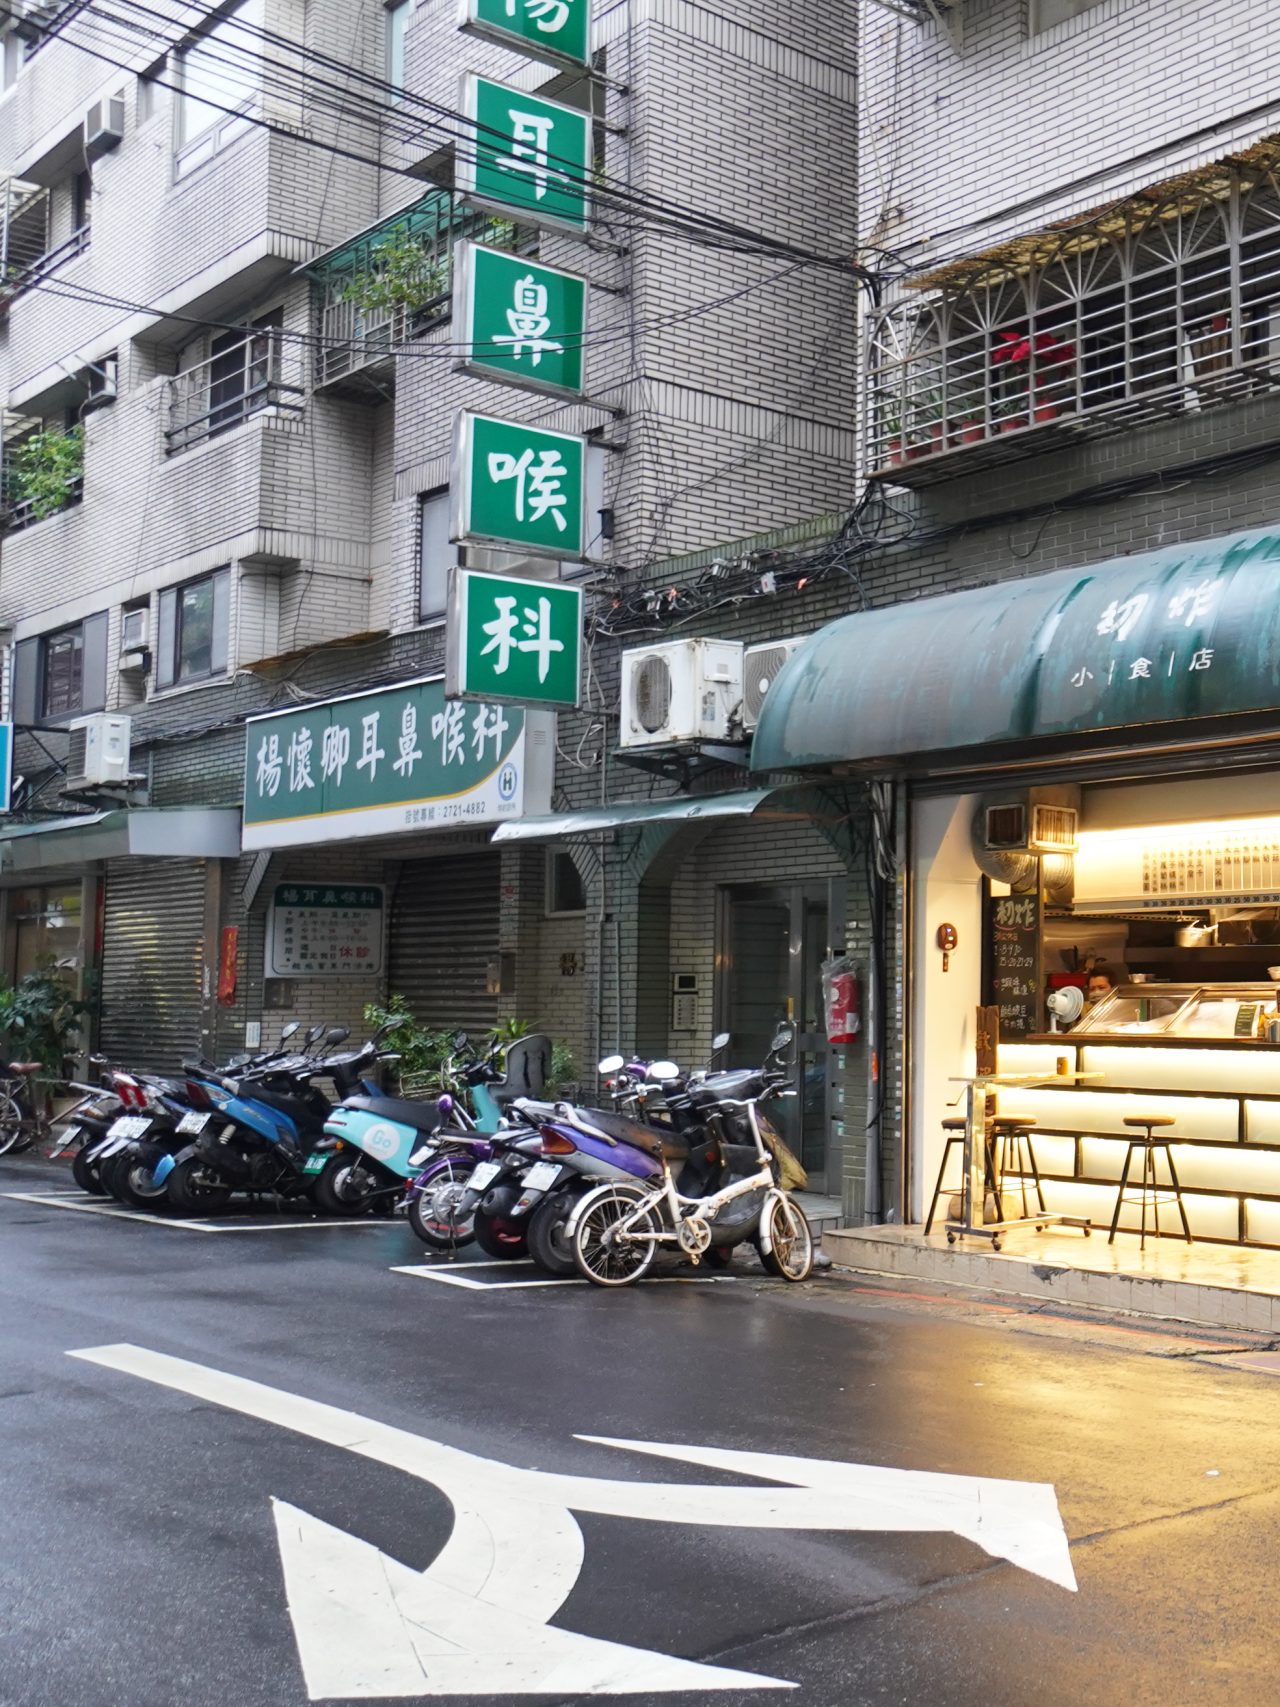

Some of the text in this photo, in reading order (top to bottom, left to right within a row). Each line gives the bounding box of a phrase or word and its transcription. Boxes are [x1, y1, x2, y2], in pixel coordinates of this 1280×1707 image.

[256, 701, 509, 798] 楊懷卿耳鼻喉科
